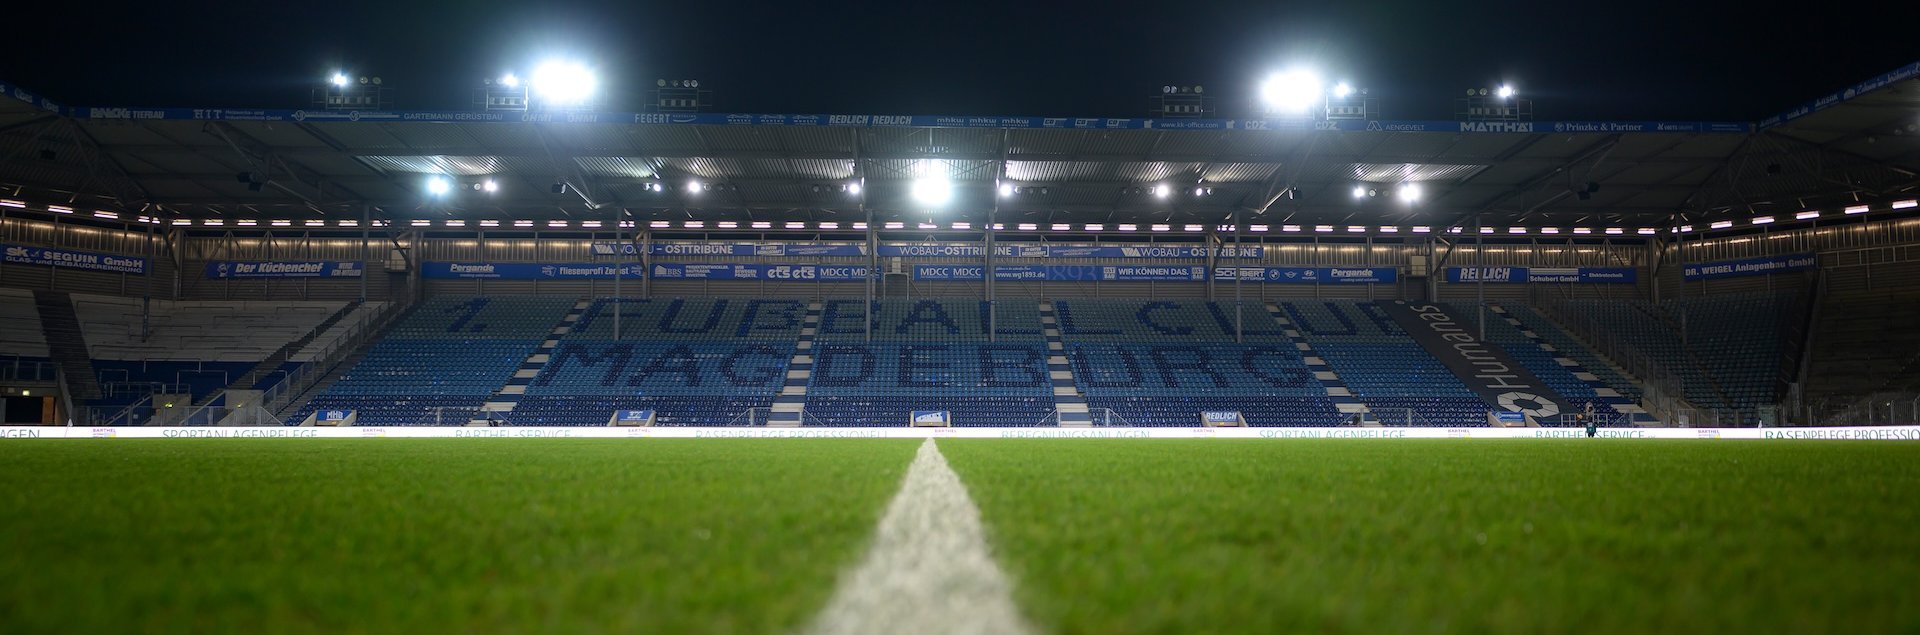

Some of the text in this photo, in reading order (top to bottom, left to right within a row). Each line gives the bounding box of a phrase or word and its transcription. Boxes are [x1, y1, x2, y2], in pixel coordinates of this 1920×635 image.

[404, 112, 503, 120] GARTEMANN GERÜSTBAU
[635, 114, 670, 124] FEGERT
[829, 115, 869, 124] REDLICH
[872, 116, 912, 125] REDLICH
[1244, 121, 1266, 129] CDZ
[1315, 121, 1337, 129] CDZ
[1460, 122, 1534, 132] MATTHÄI
[1566, 123, 1598, 131] Prinzke
[665, 244, 734, 254] OSTTRIBÜNE
[1140, 248, 1180, 256] WOBAU
[6, 247, 144, 268] sk SEGUIN GmbH
[54, 260, 142, 273] GEBÄUDEREINIGUNG
[235, 262, 324, 272] Der Küchenchef
[450, 264, 495, 272] Pergande
[1685, 257, 1814, 276] DR. WEIGEL Anlagenbau GmbH
[605, 267, 629, 275] Zerst
[820, 268, 848, 276] MDCC
[920, 268, 949, 276] MDCC
[953, 268, 982, 276] MDCC
[1136, 267, 1170, 275] KÖNNEN
[1331, 268, 1373, 277] Pergande
[1410, 304, 1531, 390] Humanas
[534, 343, 1310, 390] MAGDEBURG
[1206, 412, 1237, 420] REDLICH
